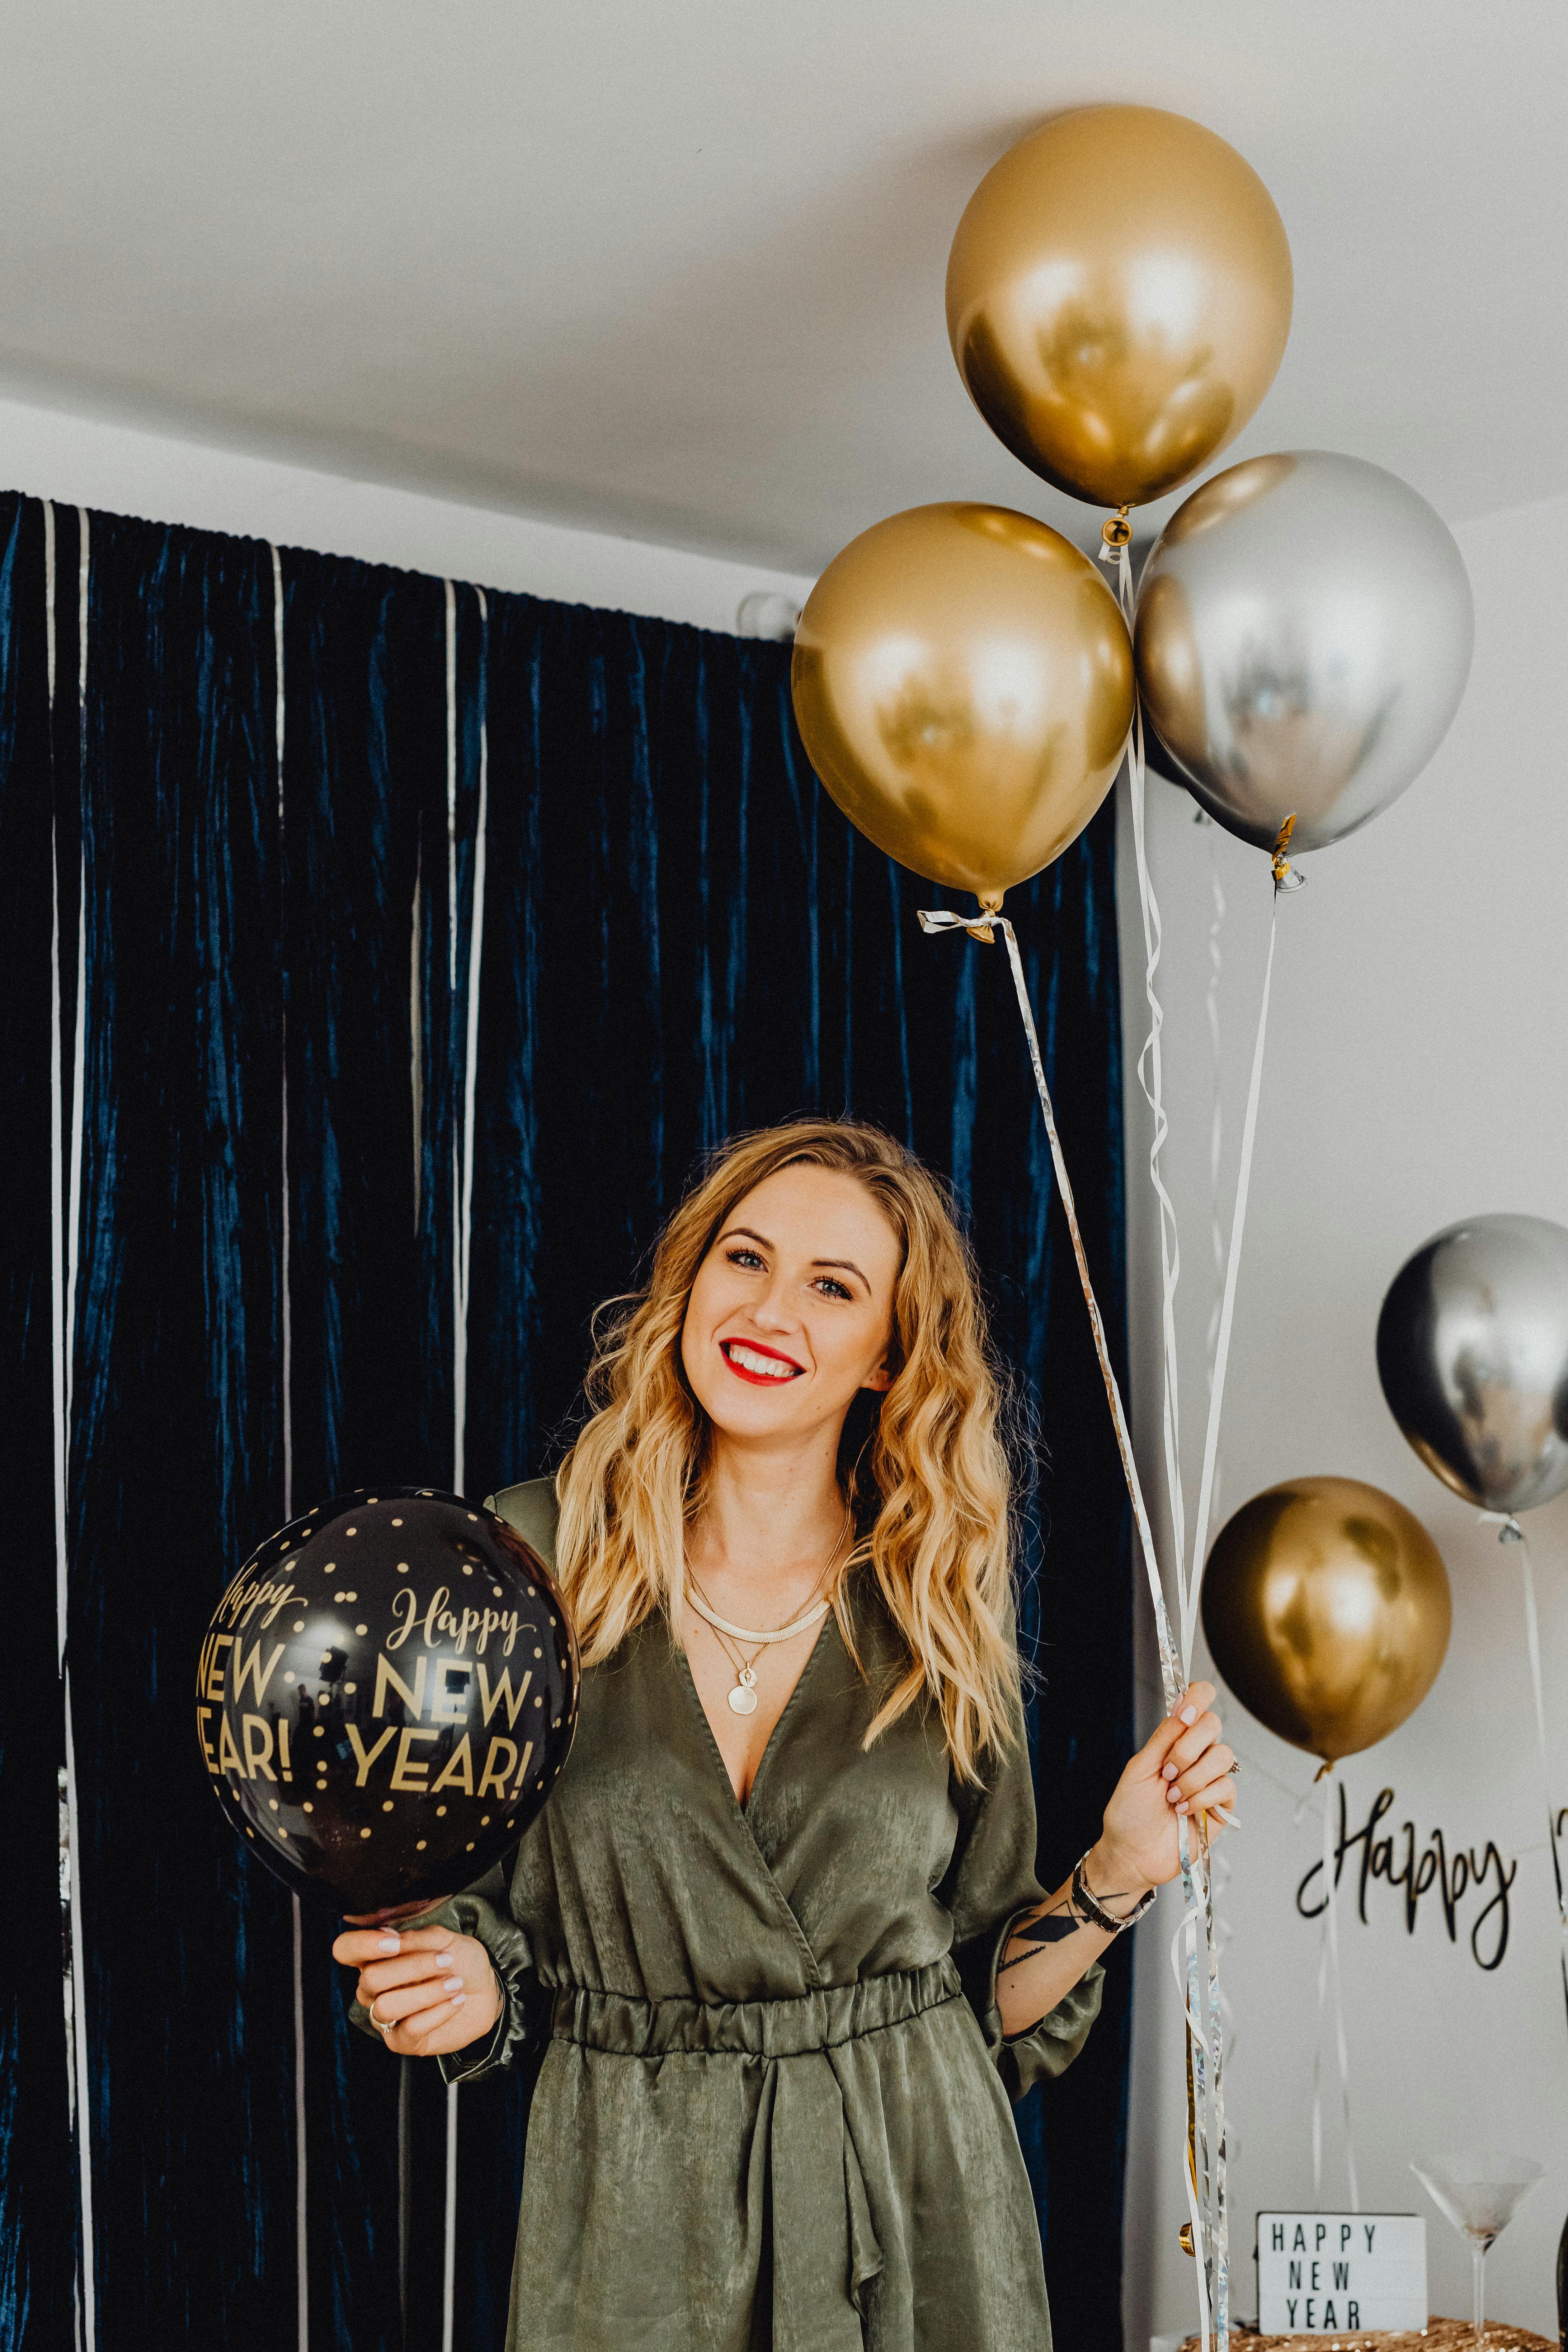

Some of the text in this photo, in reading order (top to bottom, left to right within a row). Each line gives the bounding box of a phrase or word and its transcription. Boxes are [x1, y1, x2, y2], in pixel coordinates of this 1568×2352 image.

[386, 1586, 537, 1656] Happy
[196, 1633, 286, 1708] NEW
[372, 1652, 533, 1731] NEW
[197, 1706, 293, 1782] EAR!
[345, 1723, 533, 1800] YEAR!
[1296, 1781, 1517, 1971] Happy
[1272, 2222, 1376, 2253] HAPPY
[1289, 2261, 1350, 2291] NEW
[1286, 2299, 1361, 2330] YEAR
